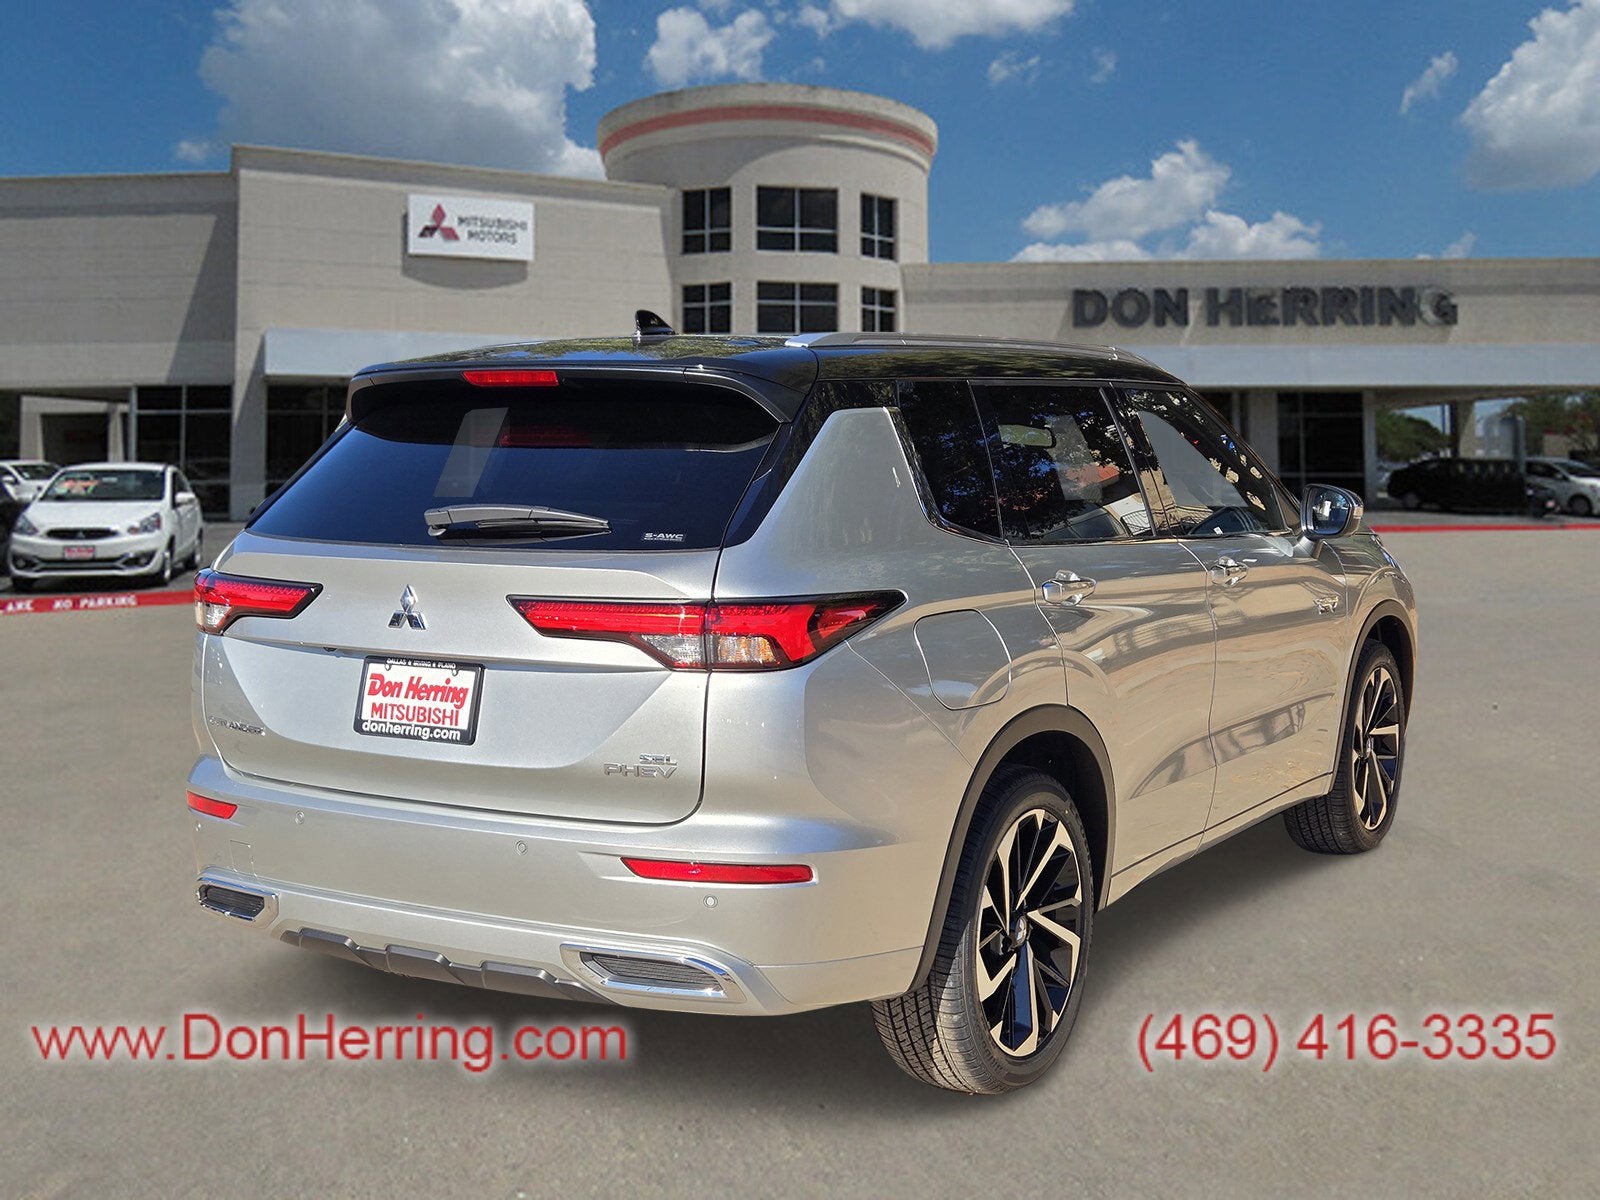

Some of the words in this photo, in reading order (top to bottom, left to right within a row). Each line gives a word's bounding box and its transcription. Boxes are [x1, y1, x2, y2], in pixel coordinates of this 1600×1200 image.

[457, 215, 528, 231] MITSUBISHI
[466, 230, 517, 245] MOTORS
[1072, 288, 1189, 328] DON
[1206, 286, 1459, 327] HERRING
[644, 532, 684, 540] S-AWC
[52, 598, 73, 610] NO
[79, 594, 137, 609] PARKING
[367, 673, 403, 698] Don
[404, 676, 469, 710] Herring
[371, 702, 459, 727] MITSUBISHI
[362, 720, 461, 740] donherring.com
[639, 753, 678, 766] SEL
[604, 761, 678, 779] PHEV
